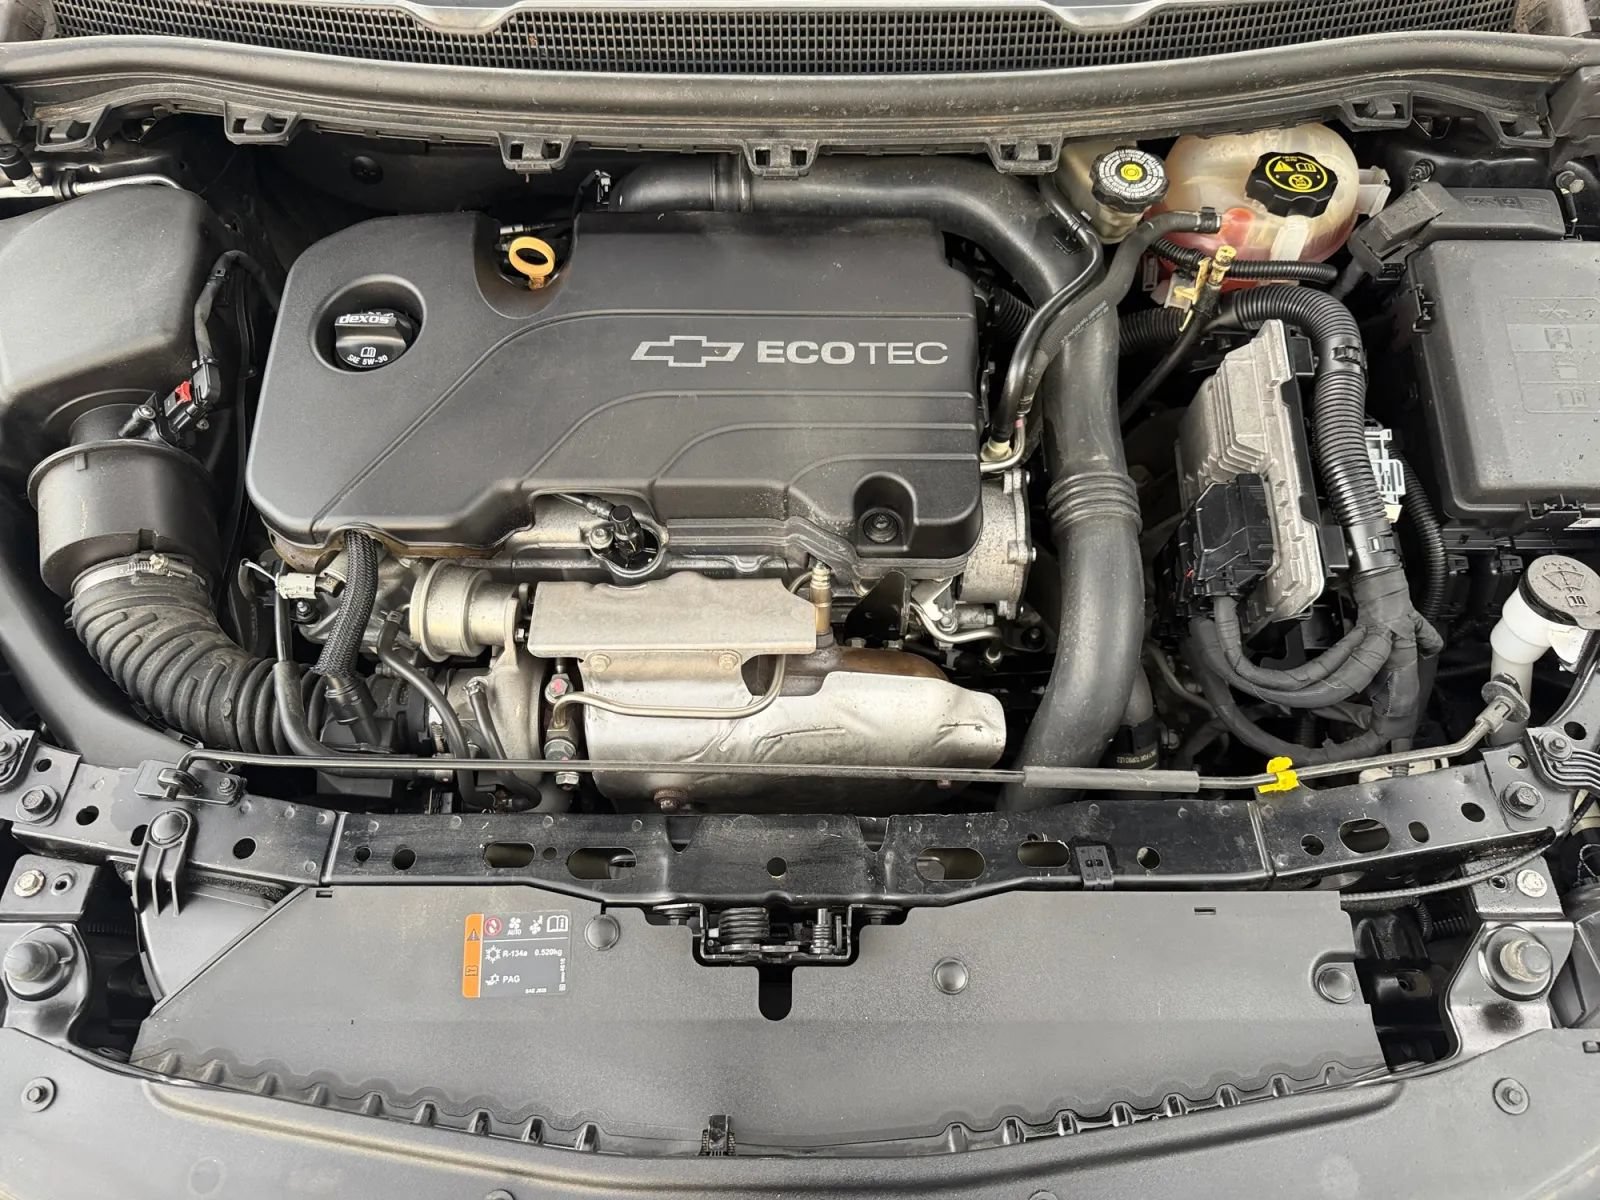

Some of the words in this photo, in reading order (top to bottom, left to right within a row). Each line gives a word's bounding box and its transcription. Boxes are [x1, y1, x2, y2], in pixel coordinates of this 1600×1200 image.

[339, 314, 390, 324] dexos
[757, 340, 949, 365] ECOTEC
[347, 354, 361, 364] SAE
[362, 354, 389, 365] 5W-30
[507, 928, 522, 936] AUTO
[502, 975, 520, 983] PAG
